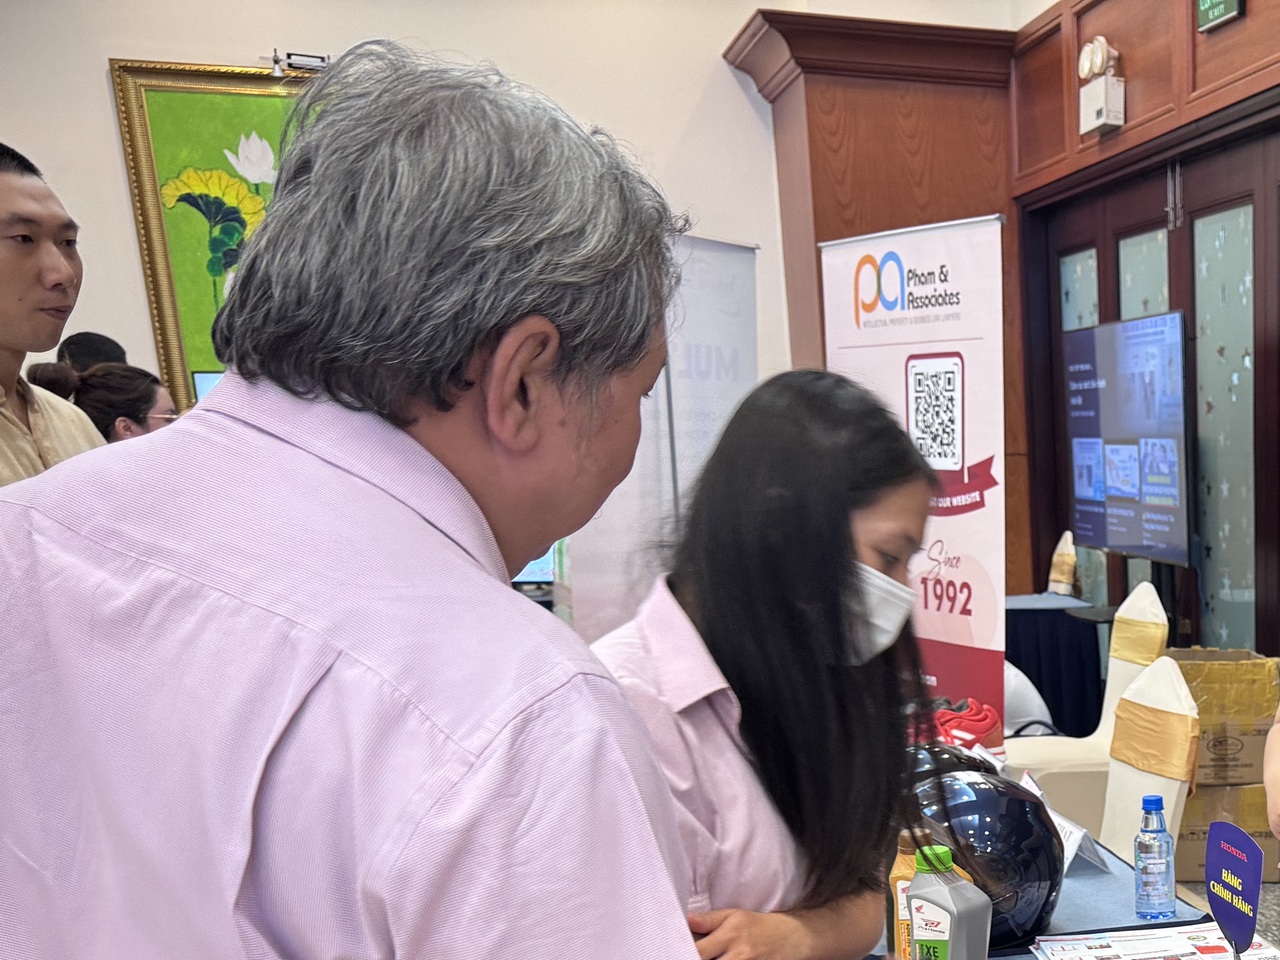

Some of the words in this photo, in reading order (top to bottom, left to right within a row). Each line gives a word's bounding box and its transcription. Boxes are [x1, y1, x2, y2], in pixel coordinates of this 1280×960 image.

[907, 268, 936, 287] Pham
[938, 264, 949, 283] &
[907, 288, 960, 310] Associates
[952, 491, 981, 507] WEBSITE
[927, 540, 961, 581] Since
[921, 577, 972, 616] 1992
[1221, 840, 1248, 863] HONDA
[1222, 868, 1242, 891] HÀNG
[1210, 880, 1231, 903] CHÍNH
